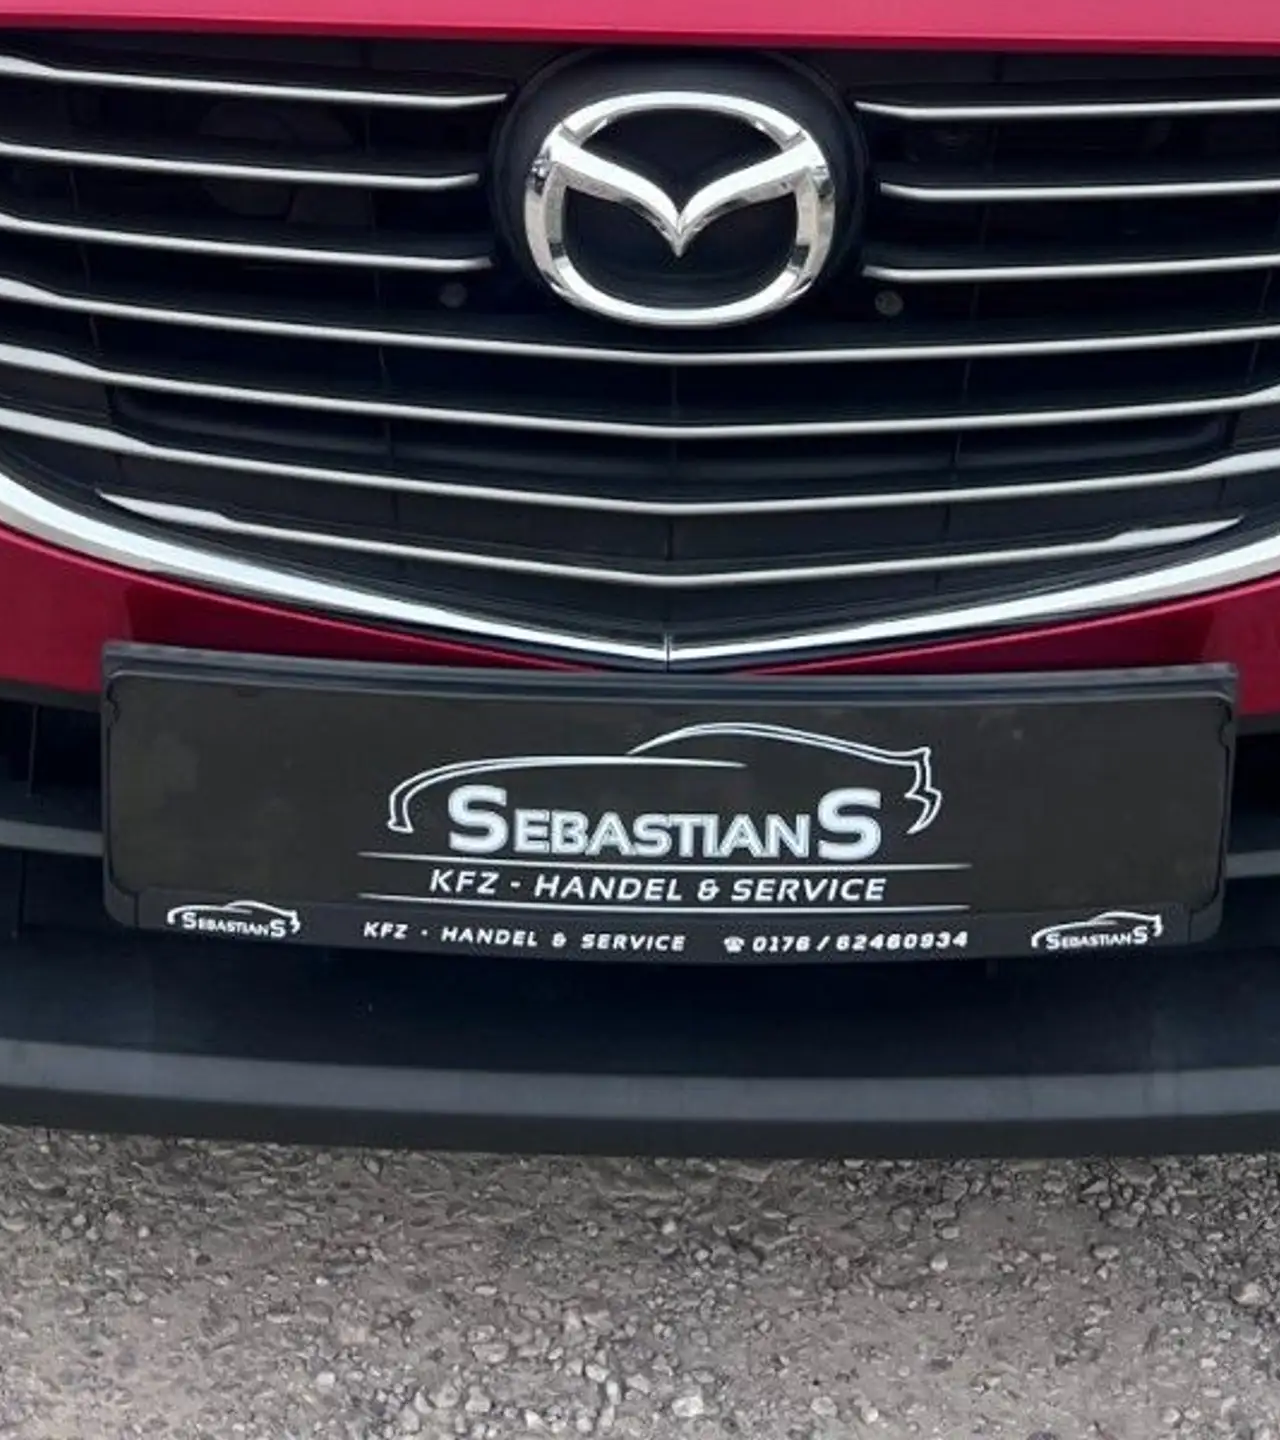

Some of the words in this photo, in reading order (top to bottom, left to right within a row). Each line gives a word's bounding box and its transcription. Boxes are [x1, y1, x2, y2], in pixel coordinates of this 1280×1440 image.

[447, 784, 882, 861] SEBASTIANS
[428, 868, 500, 895] KFZ
[533, 873, 683, 902] HANDEL
[696, 877, 721, 902] &
[730, 877, 887, 902] SERVICE
[362, 920, 409, 940] KFZ
[439, 925, 539, 948] HANDEL
[551, 931, 567, 948] &
[580, 932, 687, 952] SERVICE
[751, 935, 811, 953] 0176
